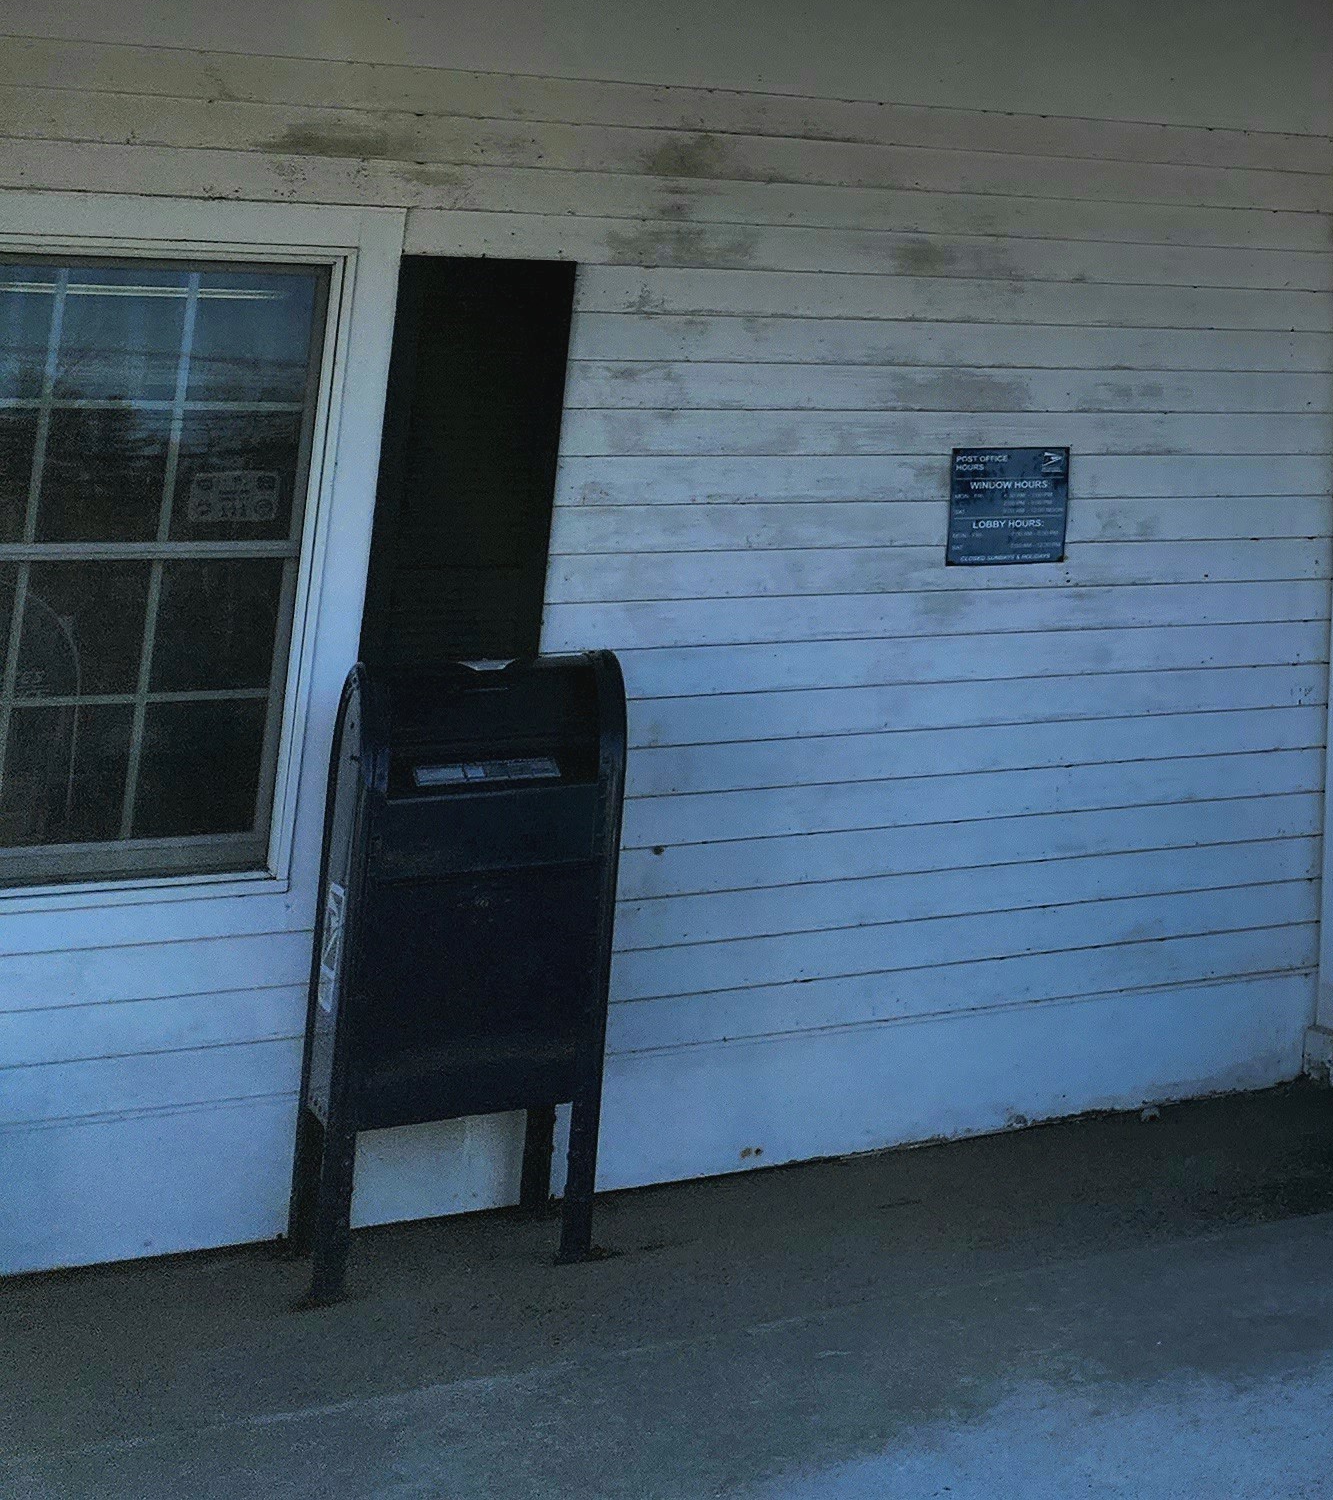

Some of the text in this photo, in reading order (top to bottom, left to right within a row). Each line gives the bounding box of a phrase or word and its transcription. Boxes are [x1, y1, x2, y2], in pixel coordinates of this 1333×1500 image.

[956, 454, 1008, 463] POST OFFICE
[955, 464, 985, 472] HOURS
[970, 481, 1012, 490] WINDOW
[972, 520, 1005, 529] LOBBY
